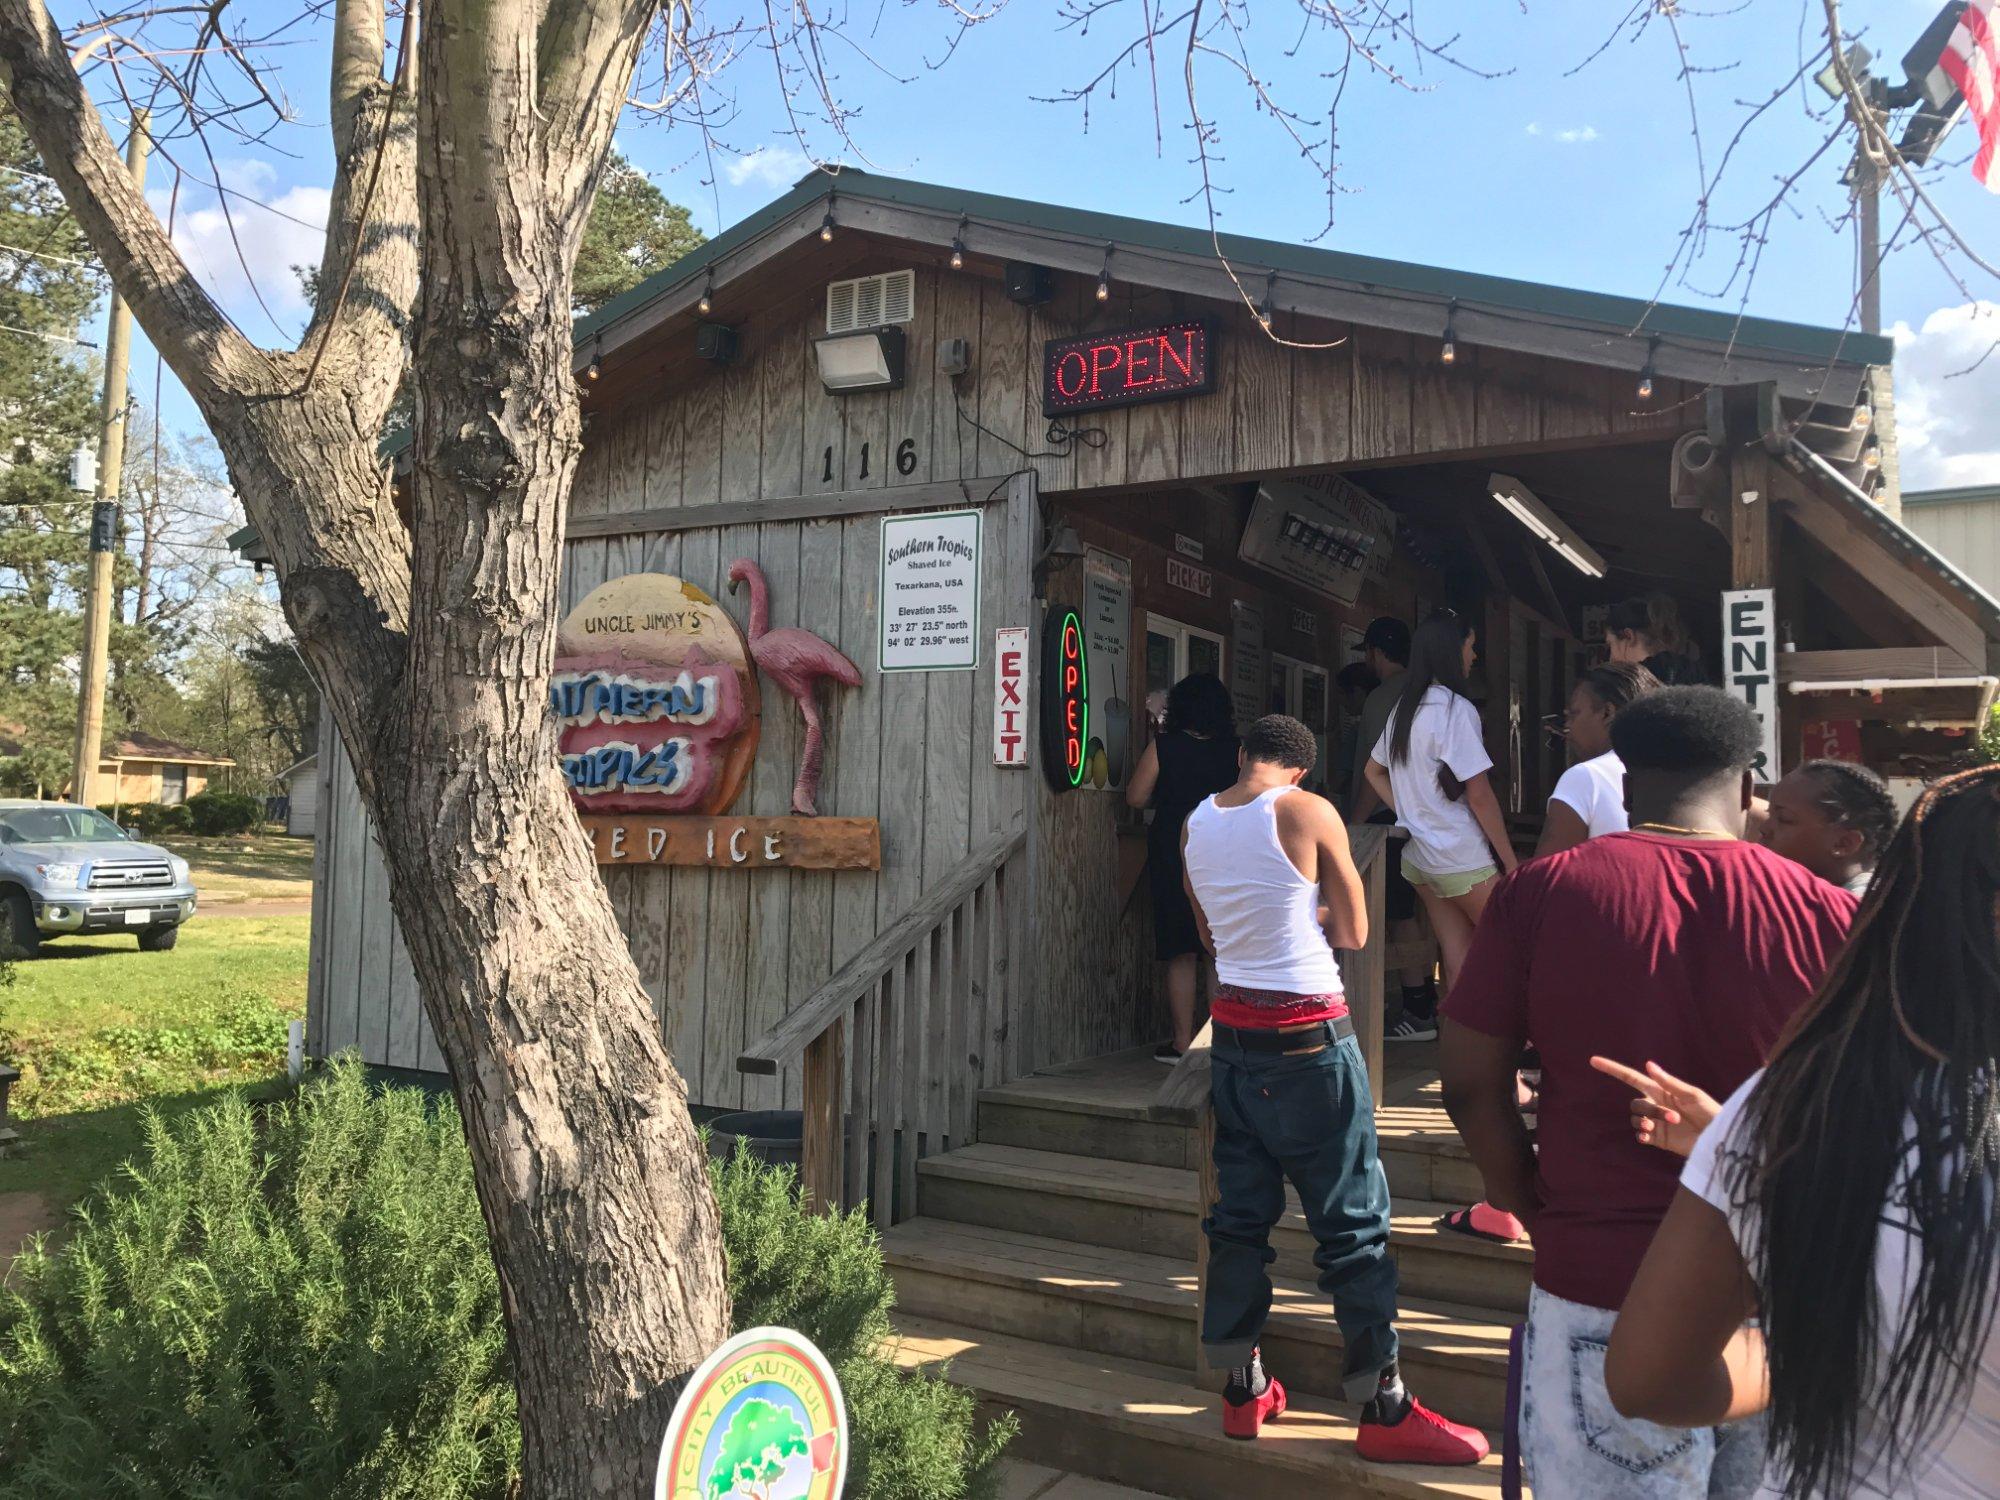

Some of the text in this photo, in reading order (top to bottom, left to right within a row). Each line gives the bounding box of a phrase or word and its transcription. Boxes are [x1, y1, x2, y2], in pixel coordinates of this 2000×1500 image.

[1055, 330, 1197, 397] OPEN
[822, 438, 918, 482] 116
[888, 535, 973, 565] Southern Tropics
[908, 559, 952, 569] Shaved Ice
[895, 579, 963, 590] Texarkana, USA
[585, 611, 701, 633] UNCLE JIMMY'S
[898, 605, 935, 616] Elevation
[946, 620, 968, 630] north
[949, 635, 969, 645] west
[551, 675, 704, 718] THERN
[1001, 651, 1021, 762] EXIT
[1731, 601, 1770, 782] ENTR
[706, 827, 783, 863] ICE
[683, 1359, 825, 1476] CITY BEAUTIFUL
